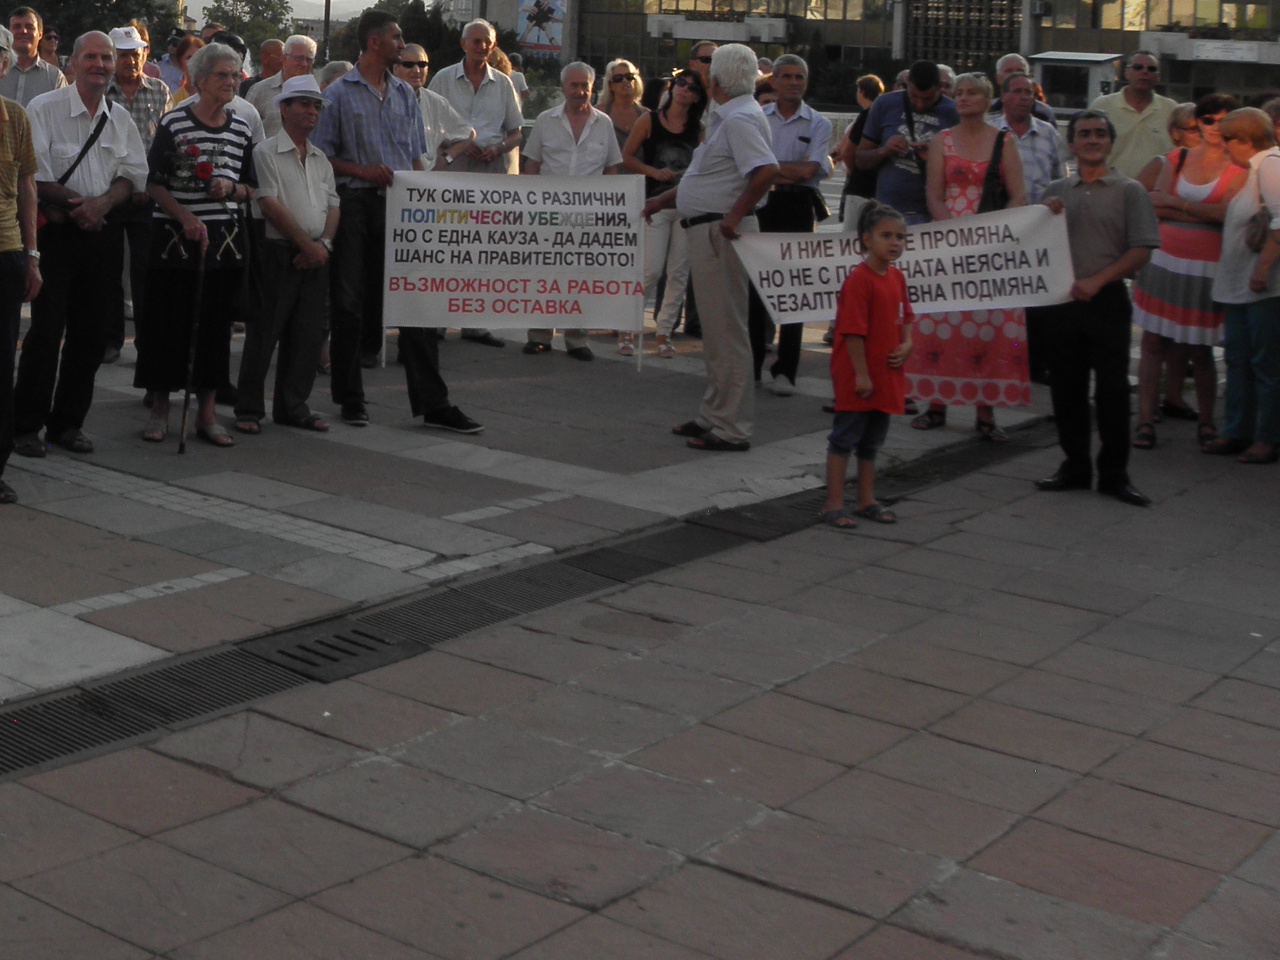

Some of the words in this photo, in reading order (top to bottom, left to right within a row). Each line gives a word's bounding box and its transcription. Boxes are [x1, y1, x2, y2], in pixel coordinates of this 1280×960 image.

[406, 188, 436, 203] ТУК
[441, 189, 475, 204] СМЕ
[480, 189, 522, 205] ХОРА
[526, 190, 537, 205] С
[543, 191, 626, 207] РАЗЛИЧНИ
[401, 208, 523, 225] ПОЛИТИЧЕСКИ
[528, 211, 631, 229] УБЕЖДЕНИЯ,
[393, 228, 417, 243] НО
[422, 229, 433, 244] С
[439, 230, 483, 248] ЕДНА
[488, 230, 539, 245] КАУЗА
[552, 231, 575, 248] ДА
[579, 232, 637, 249] ДАДЕМ
[780, 242, 792, 261] И
[798, 239, 834, 259] НИЕ
[920, 224, 1019, 251] ПРОМЯНА,
[394, 248, 445, 264] ШАНС
[450, 250, 473, 265] НА
[478, 250, 635, 267] ПРАВИТЕЛСТВОТО!
[758, 269, 784, 289] НО
[789, 268, 814, 287] НЕ
[818, 266, 830, 285] С
[952, 250, 1031, 275] НЕЯСНА
[1036, 248, 1050, 268] И
[389, 276, 531, 294] ВЪЗМОЖНОСТ
[536, 279, 561, 294] ЗА
[568, 280, 645, 297] РАБОТА
[951, 275, 1049, 302] ПОДМЯНА
[448, 298, 485, 313] БЕЗ
[492, 299, 582, 315] ОСТАВКА
